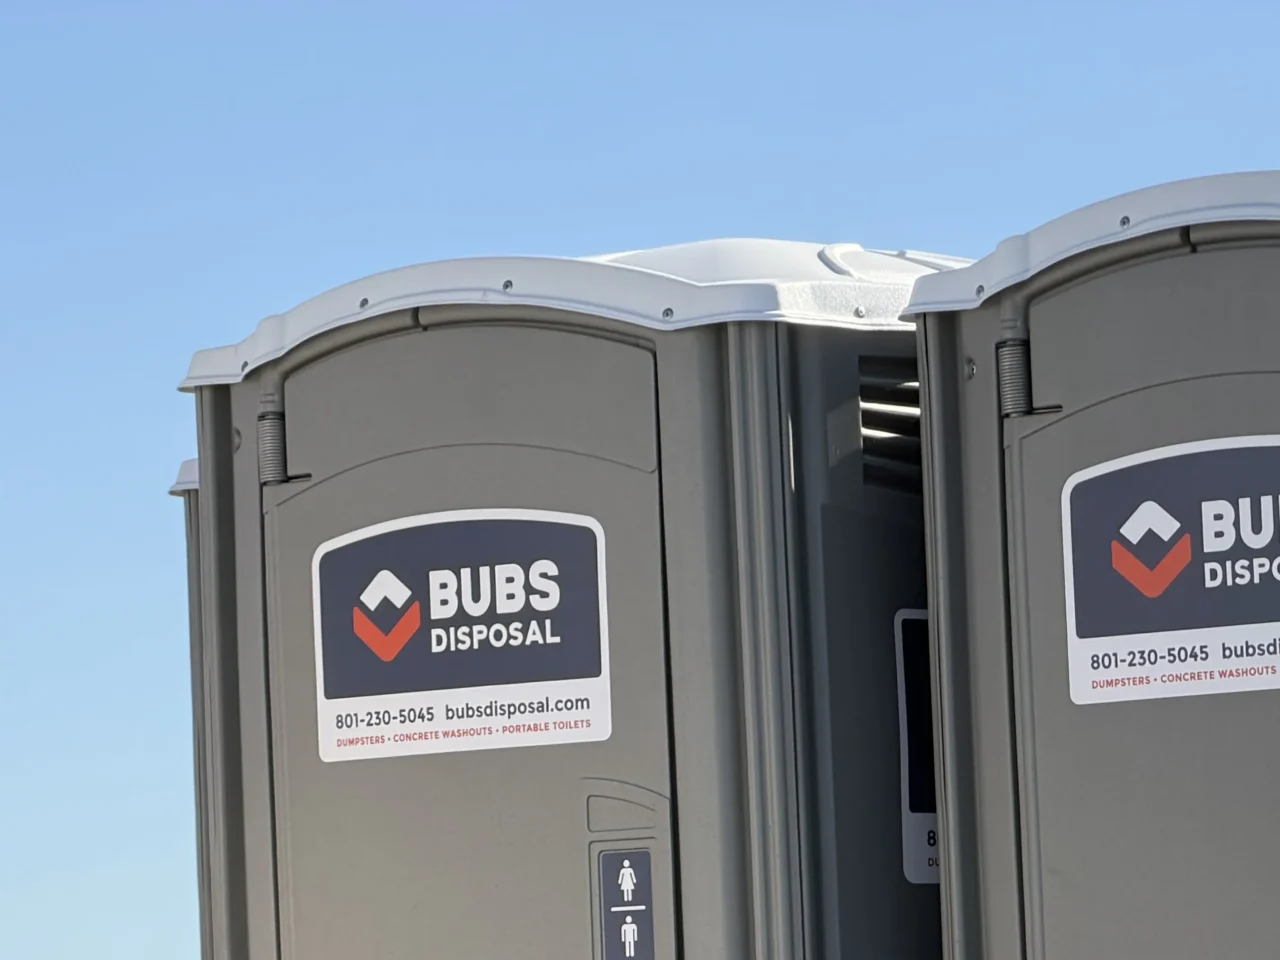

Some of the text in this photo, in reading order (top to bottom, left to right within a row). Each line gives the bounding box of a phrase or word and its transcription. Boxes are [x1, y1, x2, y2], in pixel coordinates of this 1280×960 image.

[428, 559, 561, 620] BUBS
[431, 619, 561, 653] DISPOSAL
[1090, 645, 1209, 670] 801-230-5045
[1091, 675, 1151, 689] DUMPSTERS
[1160, 670, 1215, 684] CONCRETE
[1217, 665, 1277, 679] WASHOUTS
[335, 696, 590, 729] 801-230-5045 bubsdisposal.com
[336, 719, 591, 748] DUMPSTERS CONCRETE WASHOUTS PORTABLE TOILETS
